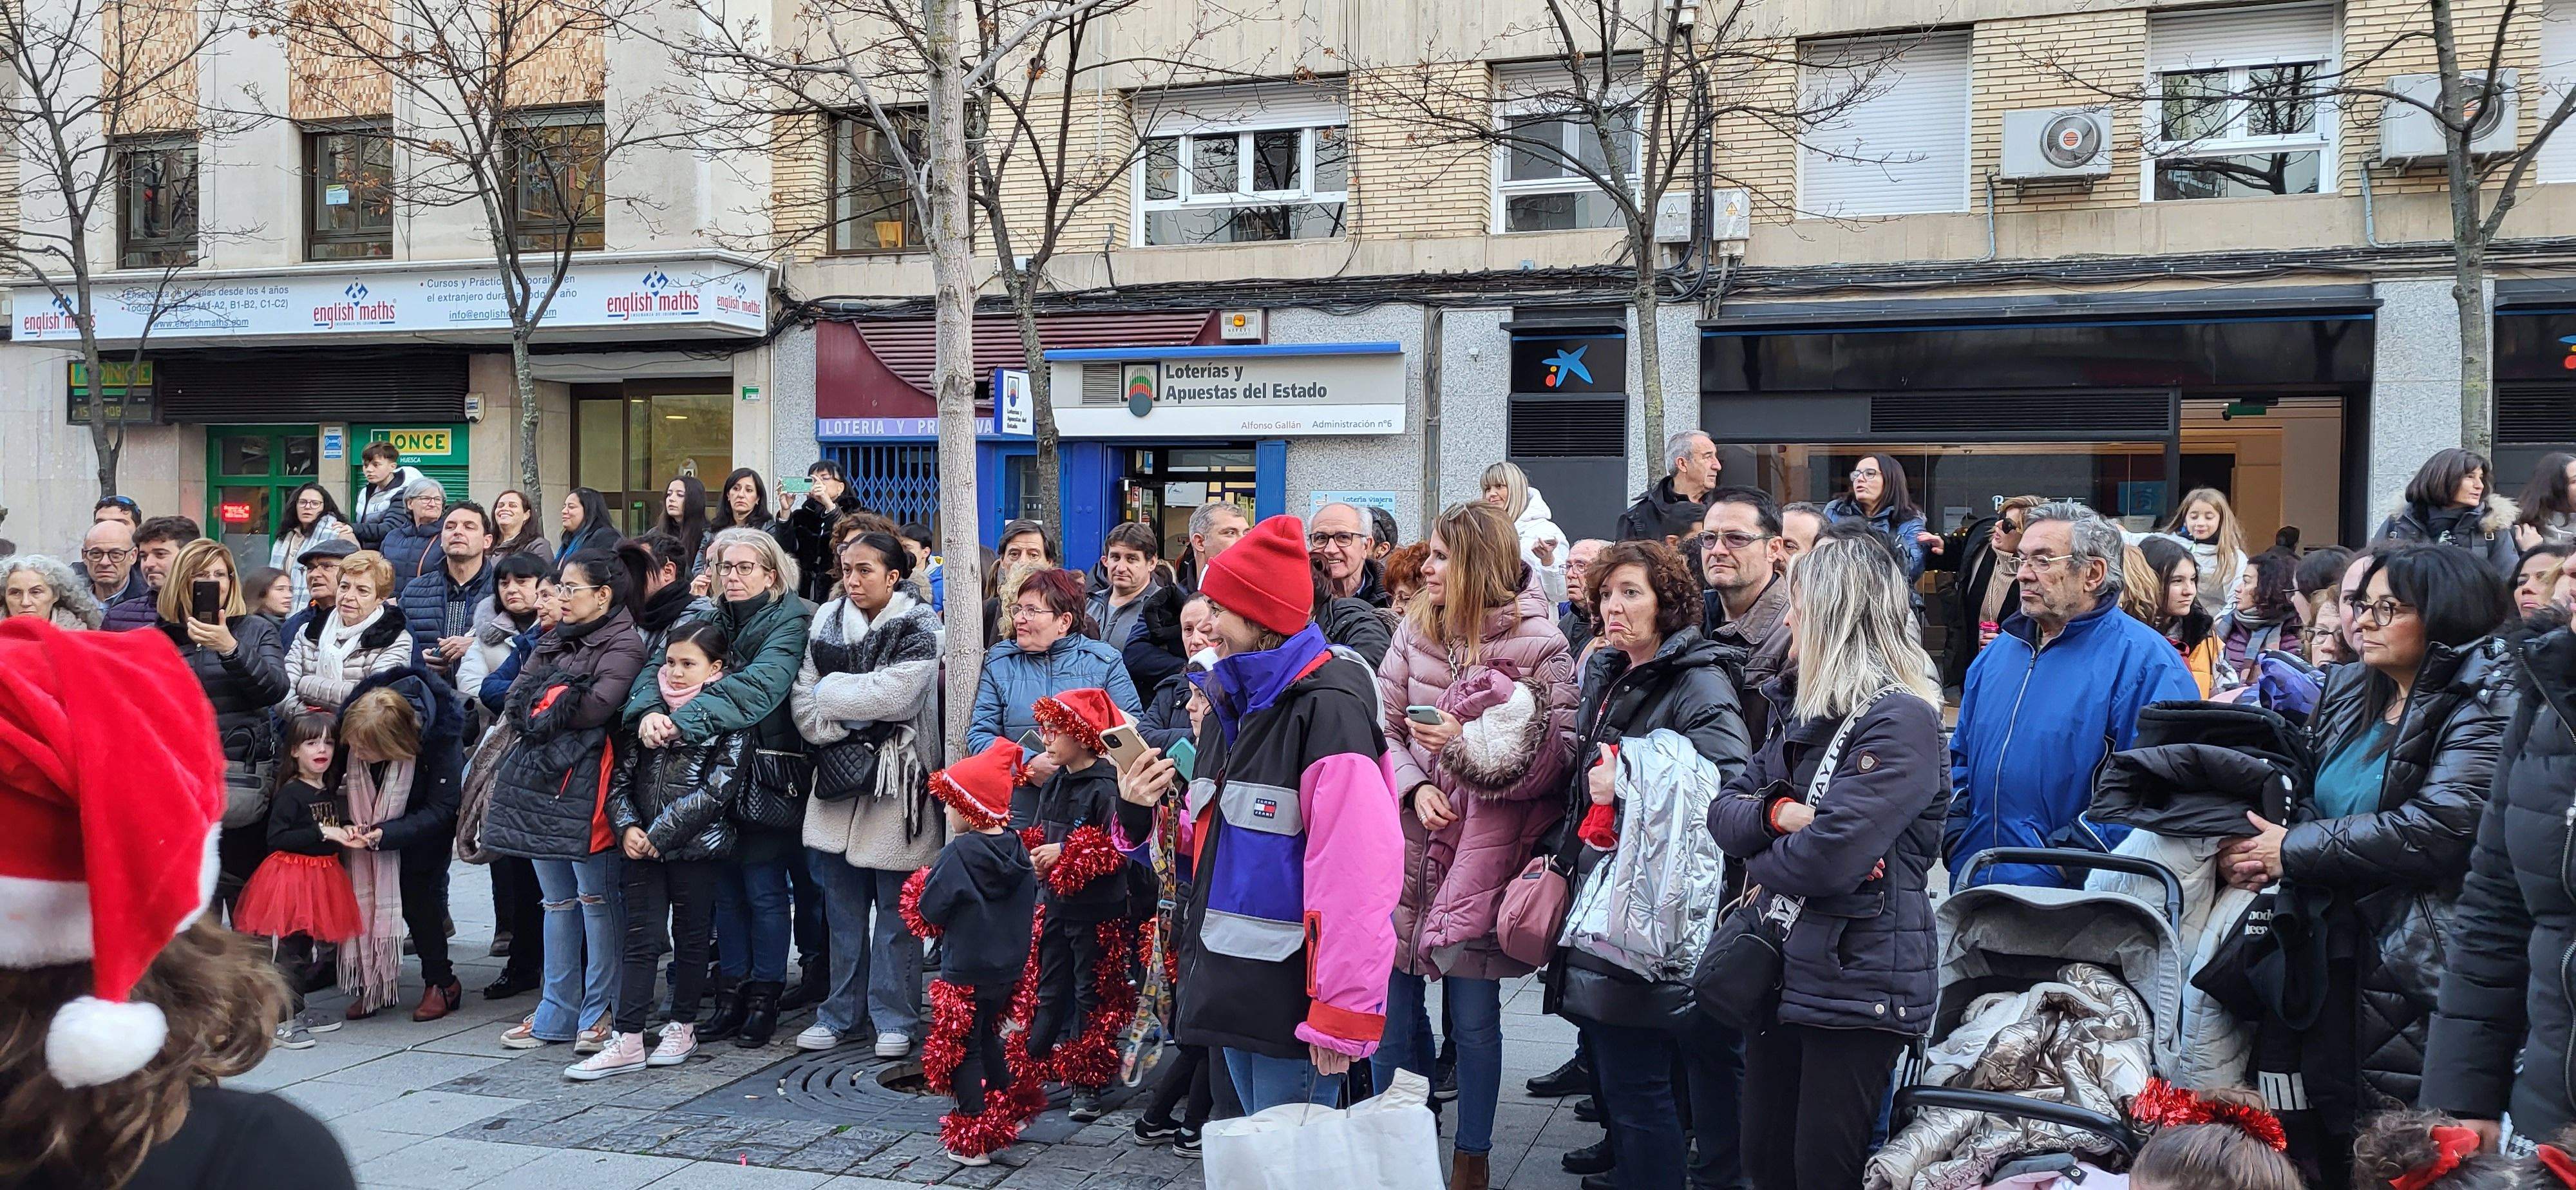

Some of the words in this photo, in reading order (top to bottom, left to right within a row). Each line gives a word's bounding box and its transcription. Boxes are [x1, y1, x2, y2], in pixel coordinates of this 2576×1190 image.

[427, 279, 458, 288] Cursos
[461, 279, 466, 288] y
[470, 277, 511, 287] Práctic
[219, 287, 243, 296] desde
[247, 286, 258, 295] los
[261, 286, 265, 294] 4
[269, 285, 289, 294] años
[438, 293, 483, 303] extranjero
[486, 290, 521, 301] durae
[560, 288, 577, 298] año
[231, 299, 257, 309] B1-B2,
[260, 299, 288, 309] C1-C2)
[607, 292, 652, 320] english
[659, 290, 699, 311] maths
[717, 294, 739, 314] english
[742, 297, 761, 314] maths
[314, 302, 354, 329] english
[360, 301, 395, 320] maths
[24, 311, 59, 337] english
[153, 317, 249, 329] www.englishmaths.com
[1166, 362, 1229, 379] Loterías
[1234, 366, 1243, 381] y
[1166, 384, 1237, 404] Apuestas
[1243, 382, 1267, 399] del
[1273, 382, 1327, 399] Estado
[826, 420, 885, 435] LOTERIA
[896, 420, 905, 433] Y
[918, 420, 992, 434] PRIVA
[1275, 420, 1302, 429] Gallán
[1312, 419, 1374, 428] Administración
[394, 433, 446, 449] ONCE
